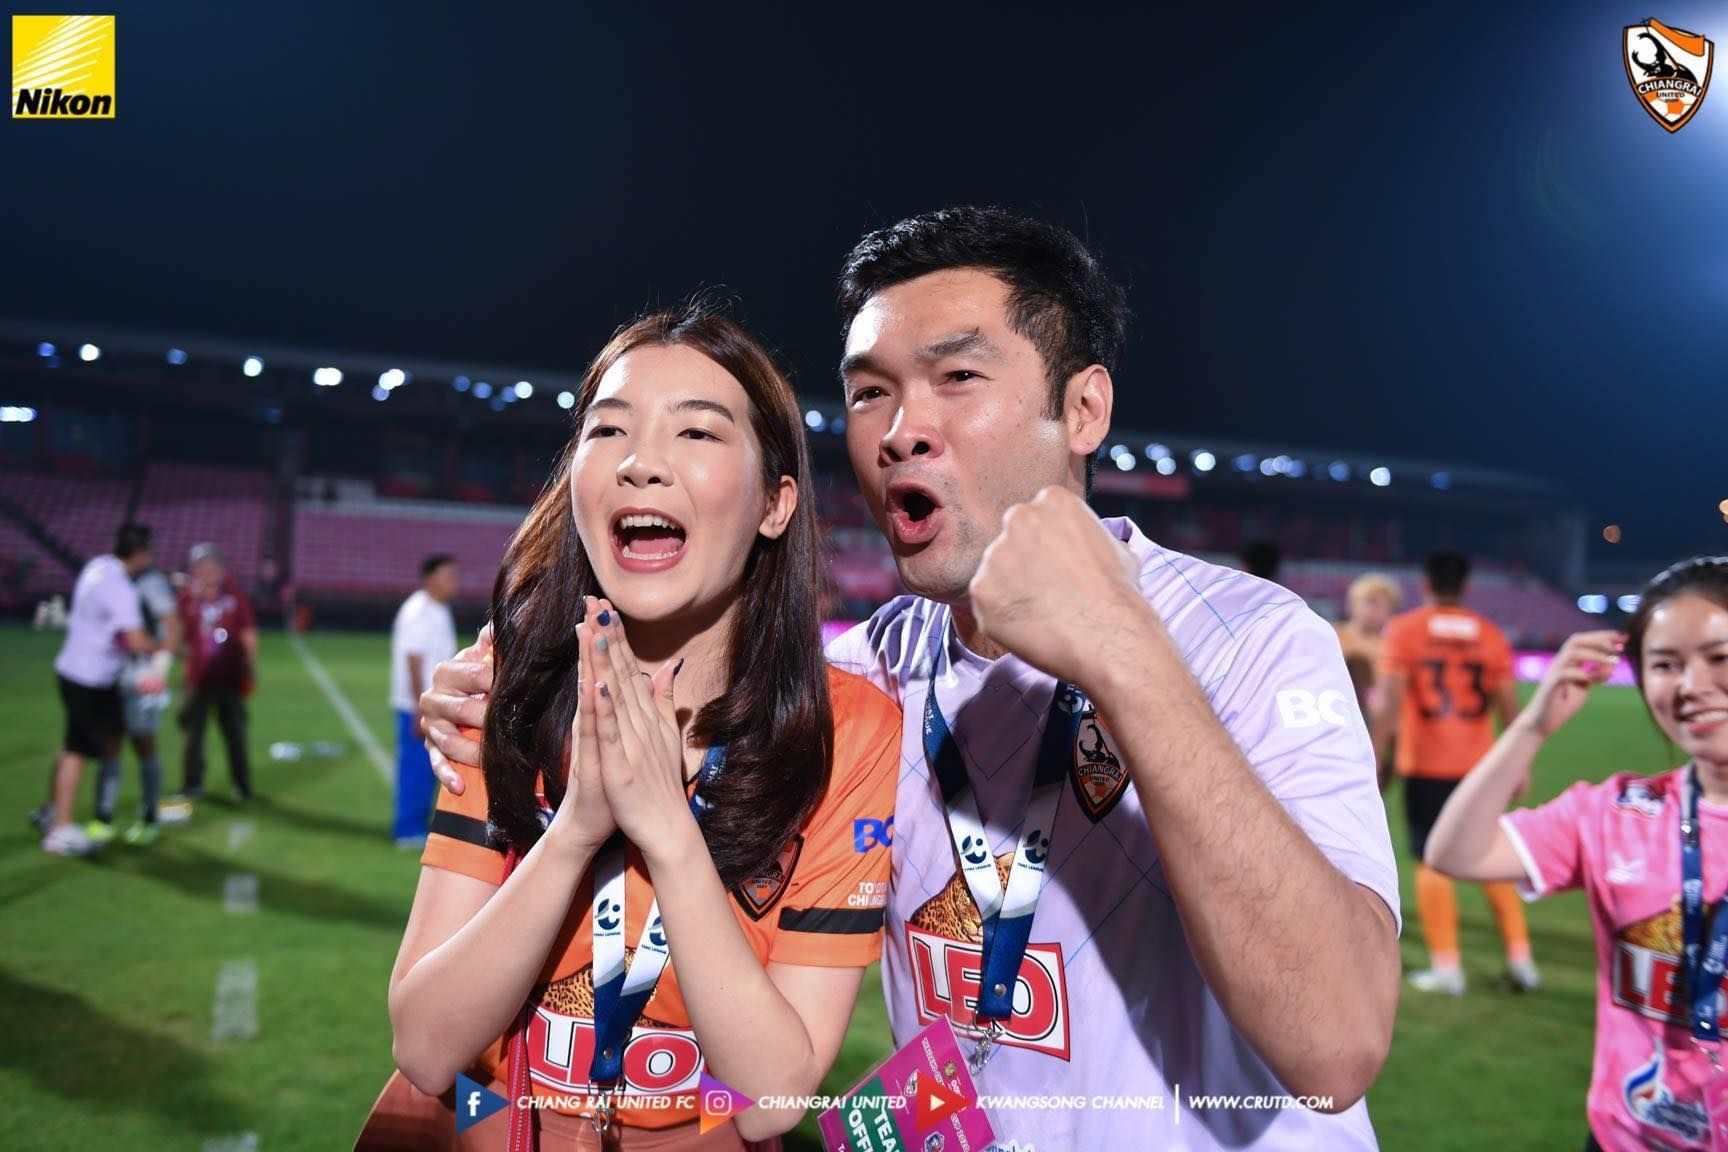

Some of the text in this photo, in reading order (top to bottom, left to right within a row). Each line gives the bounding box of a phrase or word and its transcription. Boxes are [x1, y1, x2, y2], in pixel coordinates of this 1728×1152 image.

[1417, 658, 1490, 719] 33
[1078, 765, 1124, 781] CHIANGRAI
[1620, 944, 1728, 1034] LE
[874, 1111, 901, 1152] TEA
